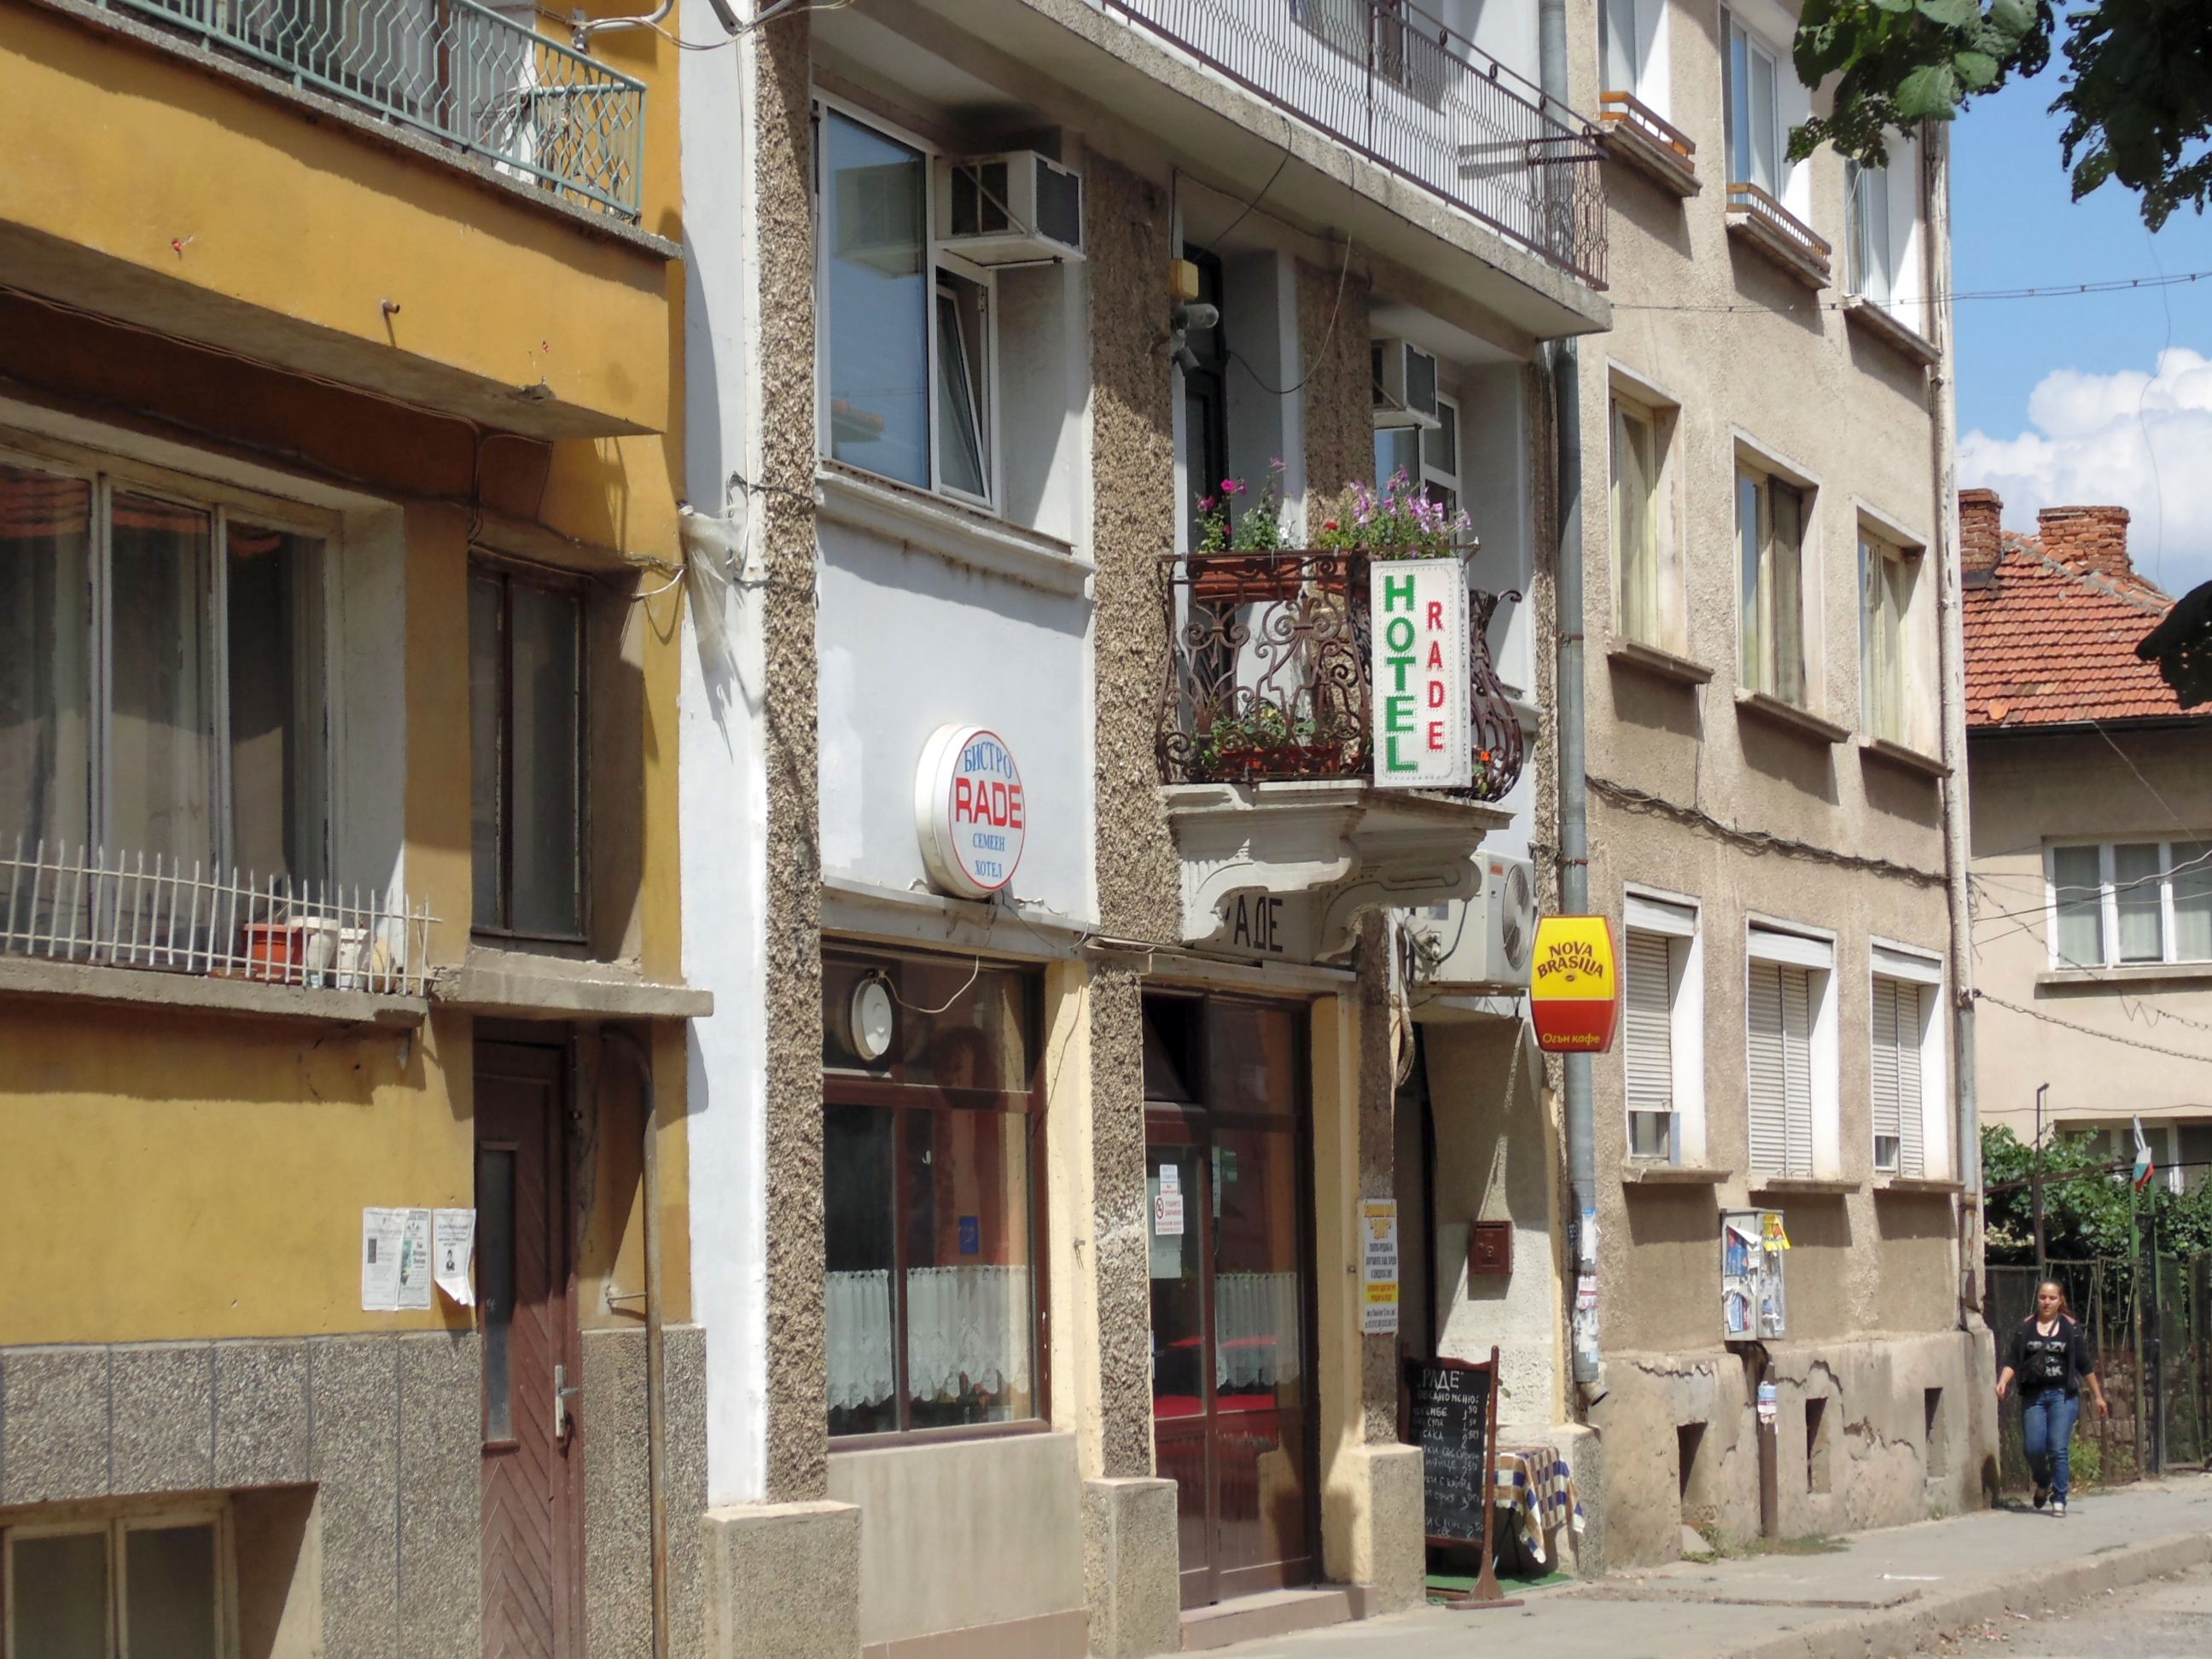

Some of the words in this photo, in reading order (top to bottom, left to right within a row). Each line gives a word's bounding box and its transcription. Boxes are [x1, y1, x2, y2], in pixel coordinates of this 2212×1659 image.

[1385, 574, 1418, 773] HOTEL
[1427, 601, 1445, 751] RADE
[963, 742, 1013, 779] БИСТРО
[955, 777, 1022, 830] RADE
[972, 832, 1005, 853] СЕМЕЕН
[975, 859, 1003, 879] ХОТЕЛ
[1225, 894, 1284, 952] АДЕ
[1548, 941, 1593, 958] NOVA
[1536, 955, 1604, 979] BRASILIA
[1542, 1033, 1570, 1045] Огън
[1571, 1033, 1601, 1046] кафе
